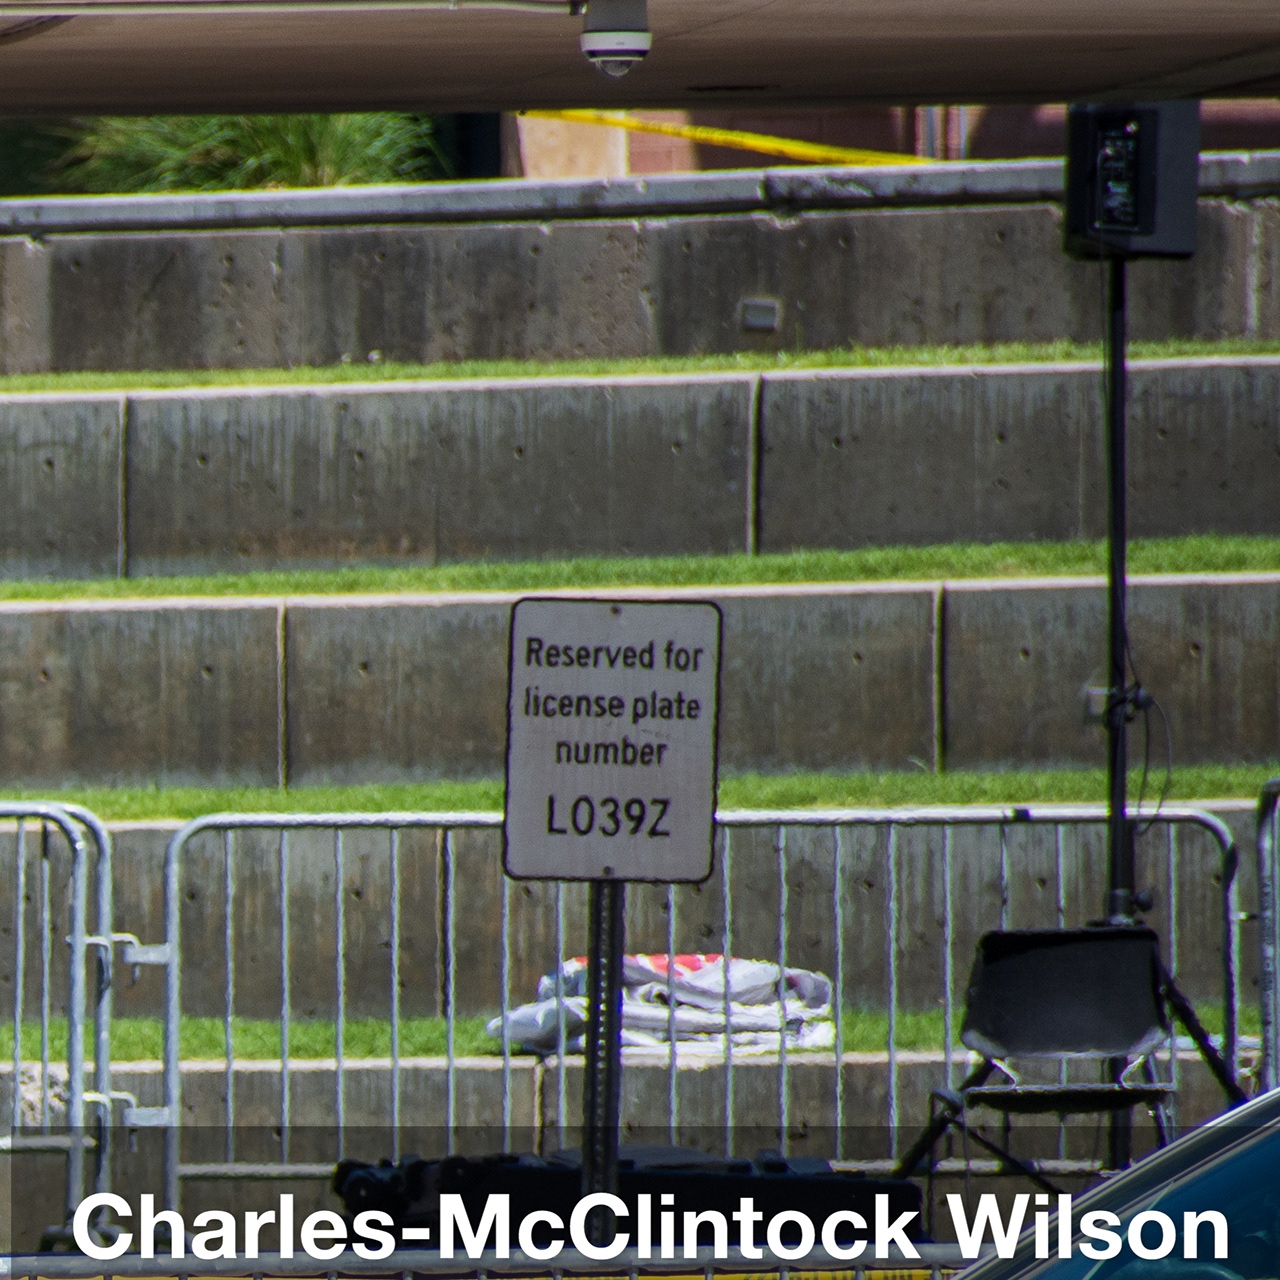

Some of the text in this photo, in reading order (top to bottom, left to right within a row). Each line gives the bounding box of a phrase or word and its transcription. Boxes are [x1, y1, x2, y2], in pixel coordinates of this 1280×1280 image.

[525, 636, 703, 672] Reserved for
[524, 686, 701, 725] license plate
[555, 735, 667, 766] number
